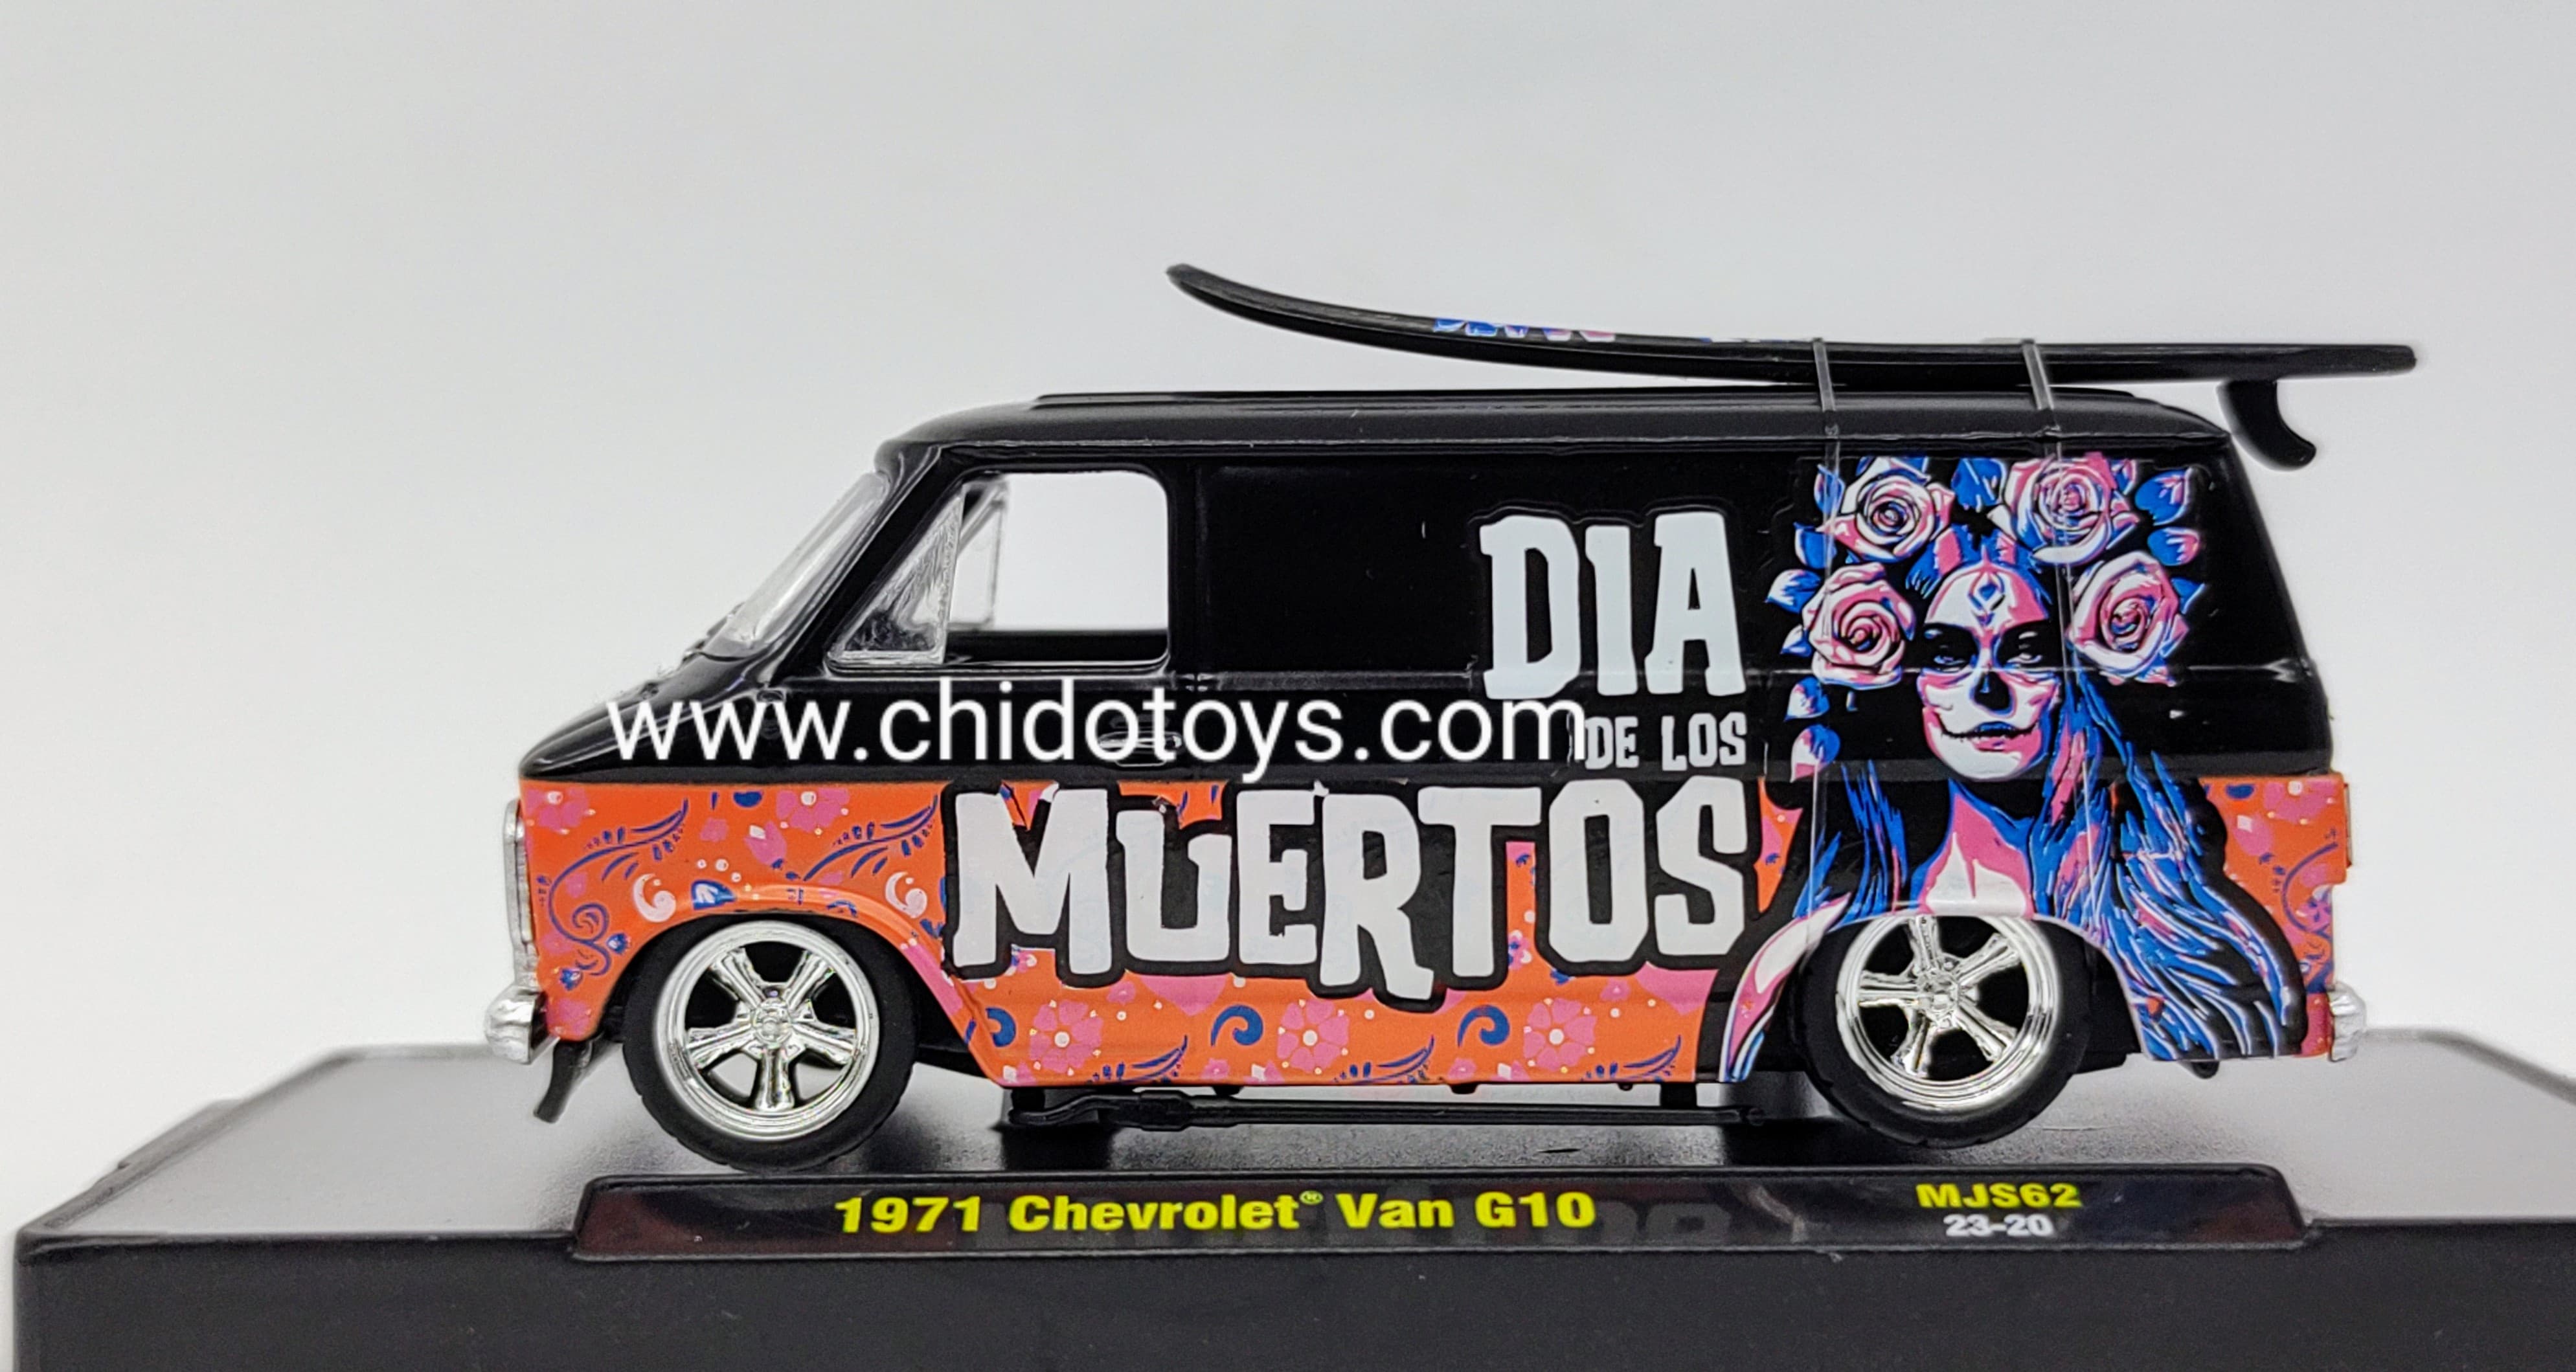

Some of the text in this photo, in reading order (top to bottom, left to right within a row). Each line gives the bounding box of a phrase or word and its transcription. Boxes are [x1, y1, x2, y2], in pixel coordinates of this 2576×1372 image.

[1480, 512, 1746, 699] DIA
[1585, 712, 1747, 771] DE LOS
[955, 776, 1747, 999] MUERTOS
[835, 1196, 982, 1233] 1971
[1335, 1192, 1454, 1229] Van
[1475, 1191, 1597, 1228] G10
[1915, 1182, 2083, 1208] MJS62
[1943, 1213, 2055, 1237] 23-20
